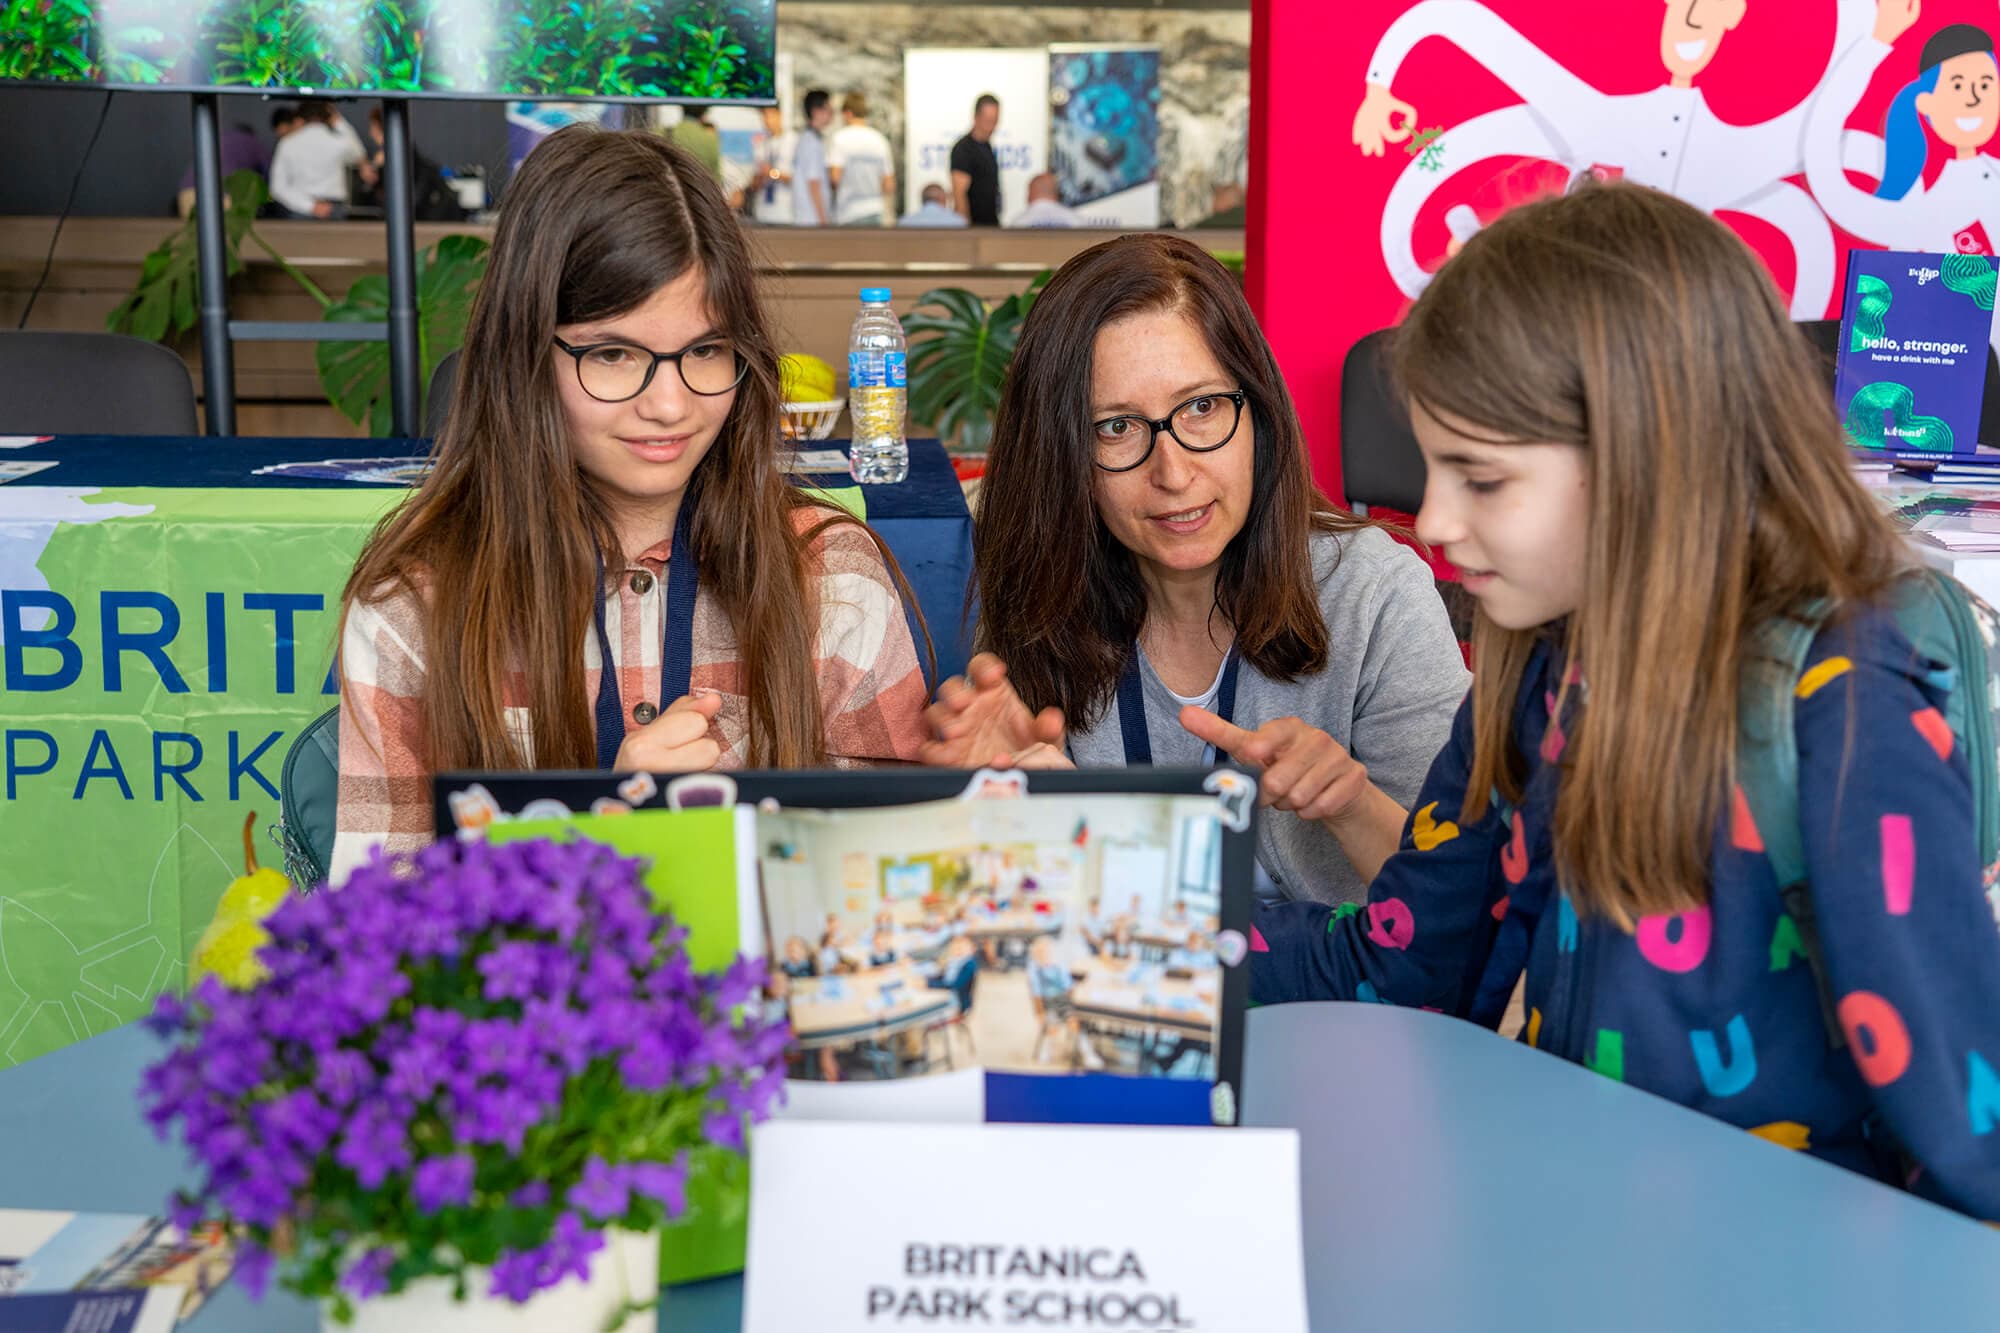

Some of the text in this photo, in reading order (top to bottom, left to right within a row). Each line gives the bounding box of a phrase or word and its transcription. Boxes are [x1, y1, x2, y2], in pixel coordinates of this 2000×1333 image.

[1862, 335, 1968, 355] hello, stranger.
[1871, 353, 1892, 362] have
[1900, 355, 1922, 364] drink
[1922, 356, 1941, 365] with
[1941, 358, 1955, 366] me
[5, 729, 285, 801] PARK
[903, 1242, 1149, 1282] BRITANICA
[867, 1285, 1196, 1329] PARK SCHOOL
